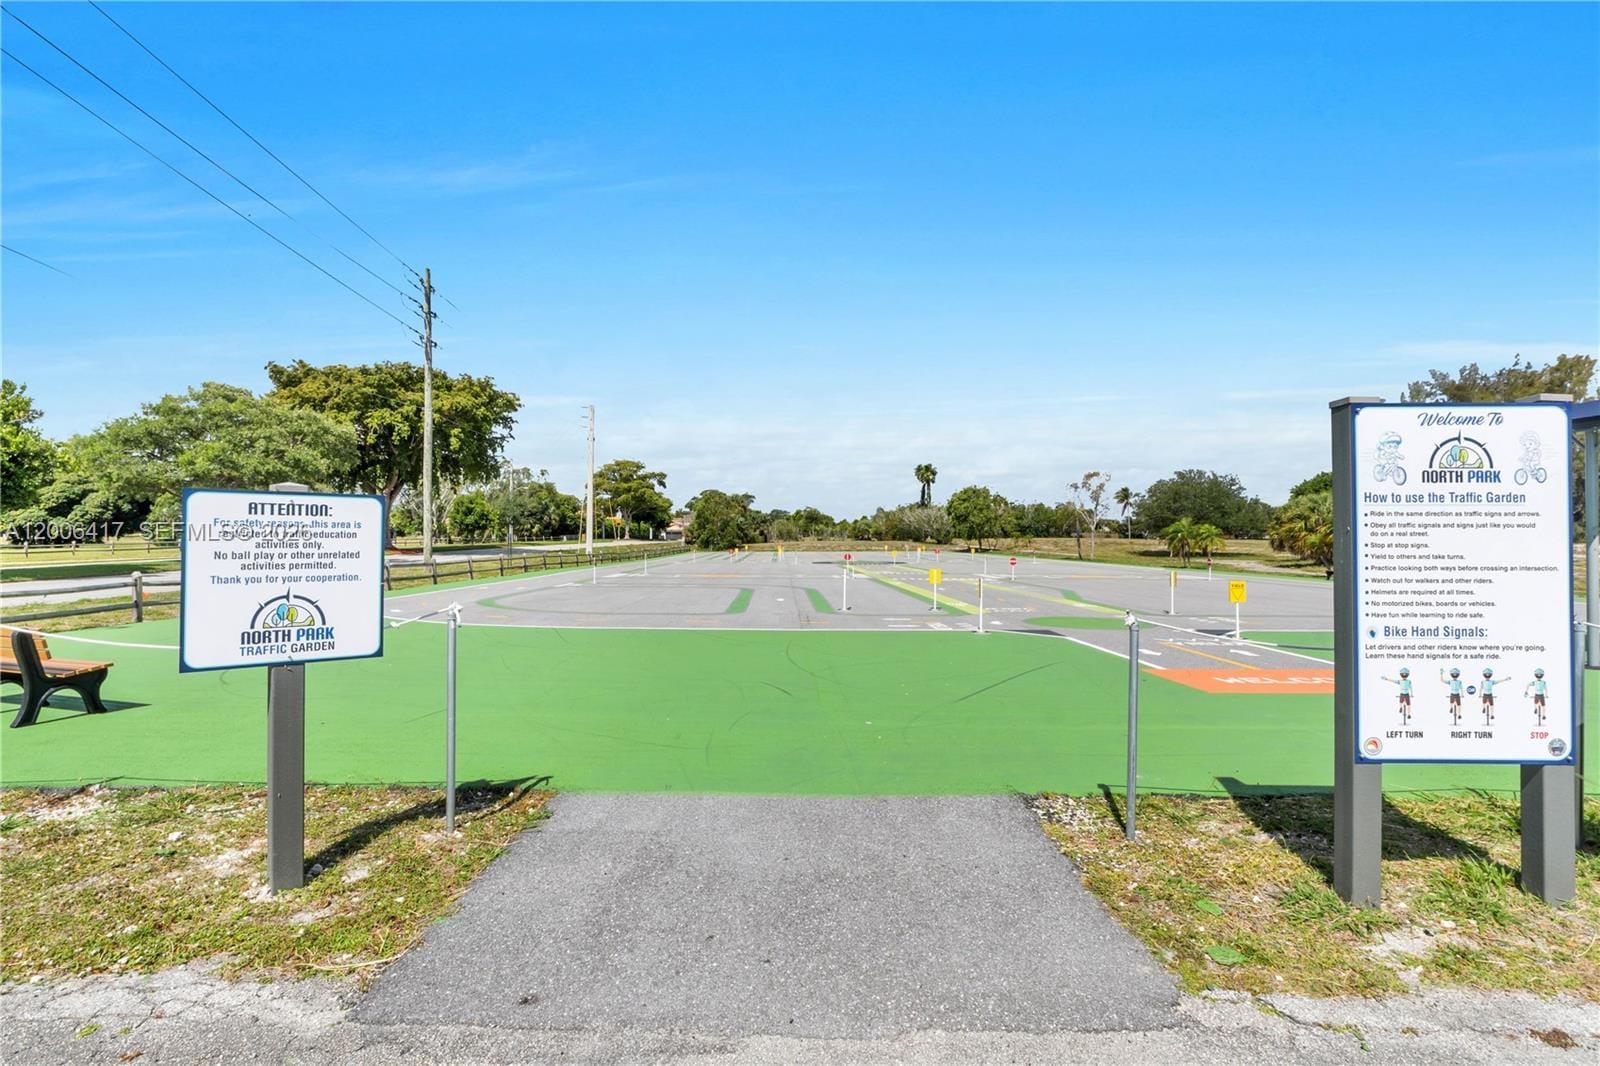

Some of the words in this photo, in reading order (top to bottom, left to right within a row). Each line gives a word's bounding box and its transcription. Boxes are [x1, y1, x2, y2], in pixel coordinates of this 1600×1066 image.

[1417, 412, 1485, 427] Welcome
[1487, 412, 1504, 426] To
[1422, 470, 1464, 484] NORTH
[1467, 470, 1502, 483] PARK
[1364, 492, 1388, 503] How
[1391, 492, 1402, 503] to
[1405, 494, 1424, 503] use
[1427, 492, 1445, 503] the
[1448, 492, 1483, 503] Traffic
[1486, 491, 1526, 503] Garden
[248, 502, 332, 517] ATTENTION:
[214, 518, 230, 527] For
[234, 518, 263, 529] safety
[312, 519, 328, 528] this
[354, 521, 362, 529] is
[1417, 522, 1441, 530] signals
[1456, 522, 1474, 530] signs
[313, 530, 357, 539] education
[255, 540, 299, 549] activities
[302, 540, 324, 551] only.
[214, 551, 228, 560] No
[231, 551, 250, 560] ball
[254, 551, 275, 562] play
[290, 551, 315, 560] other
[317, 550, 360, 559] unrelated
[240, 561, 286, 571] activities
[289, 561, 336, 571] permitted.
[210, 575, 241, 584] Thank
[244, 576, 262, 585] you
[265, 574, 279, 583] for
[281, 576, 303, 585] your
[305, 574, 362, 584] cooperation.
[241, 630, 291, 645] NORTH
[296, 627, 334, 641] PARK
[1384, 625, 1408, 637] Bike
[1411, 626, 1440, 637] Hand
[1443, 625, 1488, 640] Signals:
[240, 644, 287, 656] TRAFFIC
[291, 641, 335, 653] GARDEN
[1386, 730, 1403, 739] LEFT
[1405, 730, 1424, 739] TURN
[1450, 731, 1472, 739] RIGHT
[1474, 731, 1493, 739] TURN
